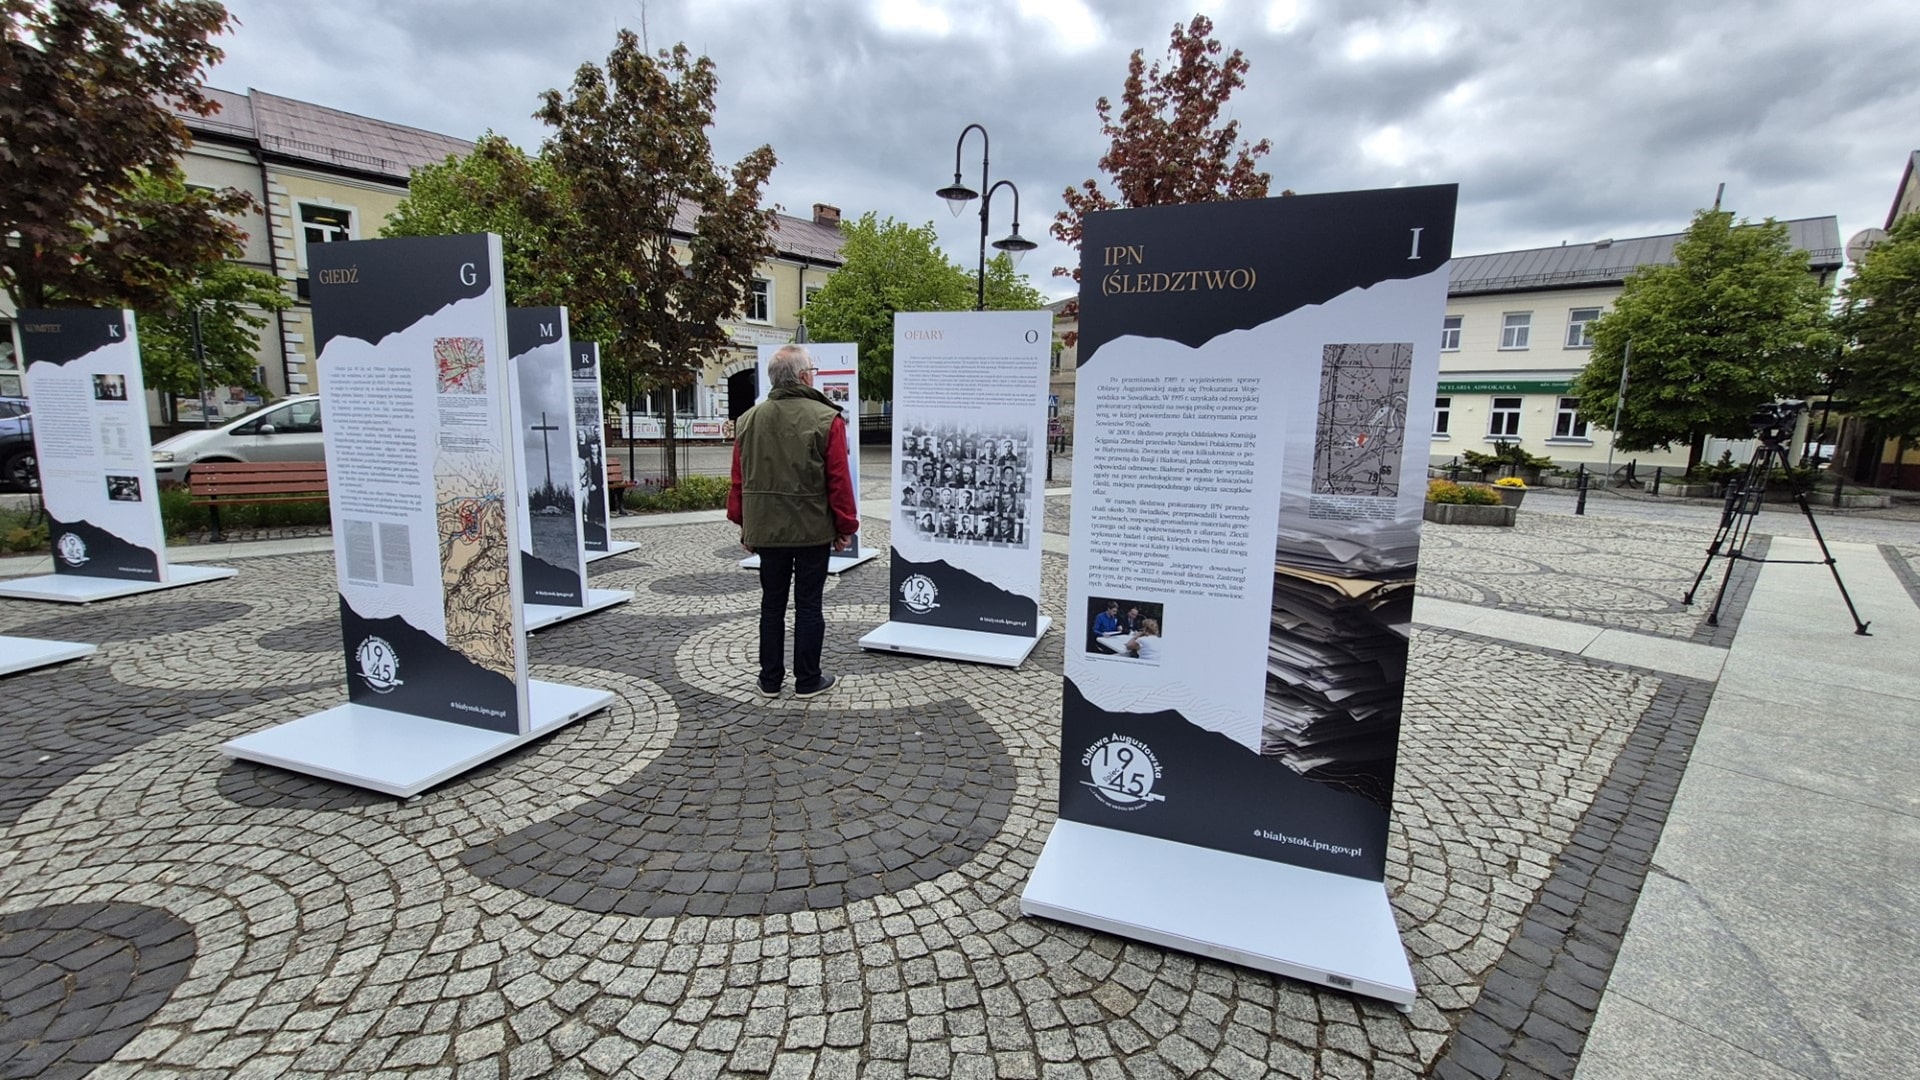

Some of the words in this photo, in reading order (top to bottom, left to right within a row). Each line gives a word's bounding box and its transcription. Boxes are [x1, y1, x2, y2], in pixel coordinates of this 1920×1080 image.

[1407, 228, 1424, 260] I
[1104, 246, 1144, 266] IPN
[319, 264, 360, 284] GIEDŹ
[460, 262, 477, 286] G
[1102, 267, 1257, 297] (ŚLEDZTWO)
[108, 324, 120, 337] K
[540, 323, 553, 337] M
[904, 330, 944, 340] OFIARY
[1024, 330, 1039, 344] O
[582, 354, 589, 363] R
[841, 356, 848, 365] U
[910, 579, 924, 592] 19
[913, 593, 929, 605] 45
[364, 645, 382, 662] 19
[372, 664, 391, 680] 45
[1082, 737, 1109, 766] Obława
[1112, 732, 1163, 778] Augustowska
[1102, 745, 1134, 770] 19
[1108, 772, 1144, 795] 45
[1263, 828, 1362, 857] bialystok.ipn.gov.pl
